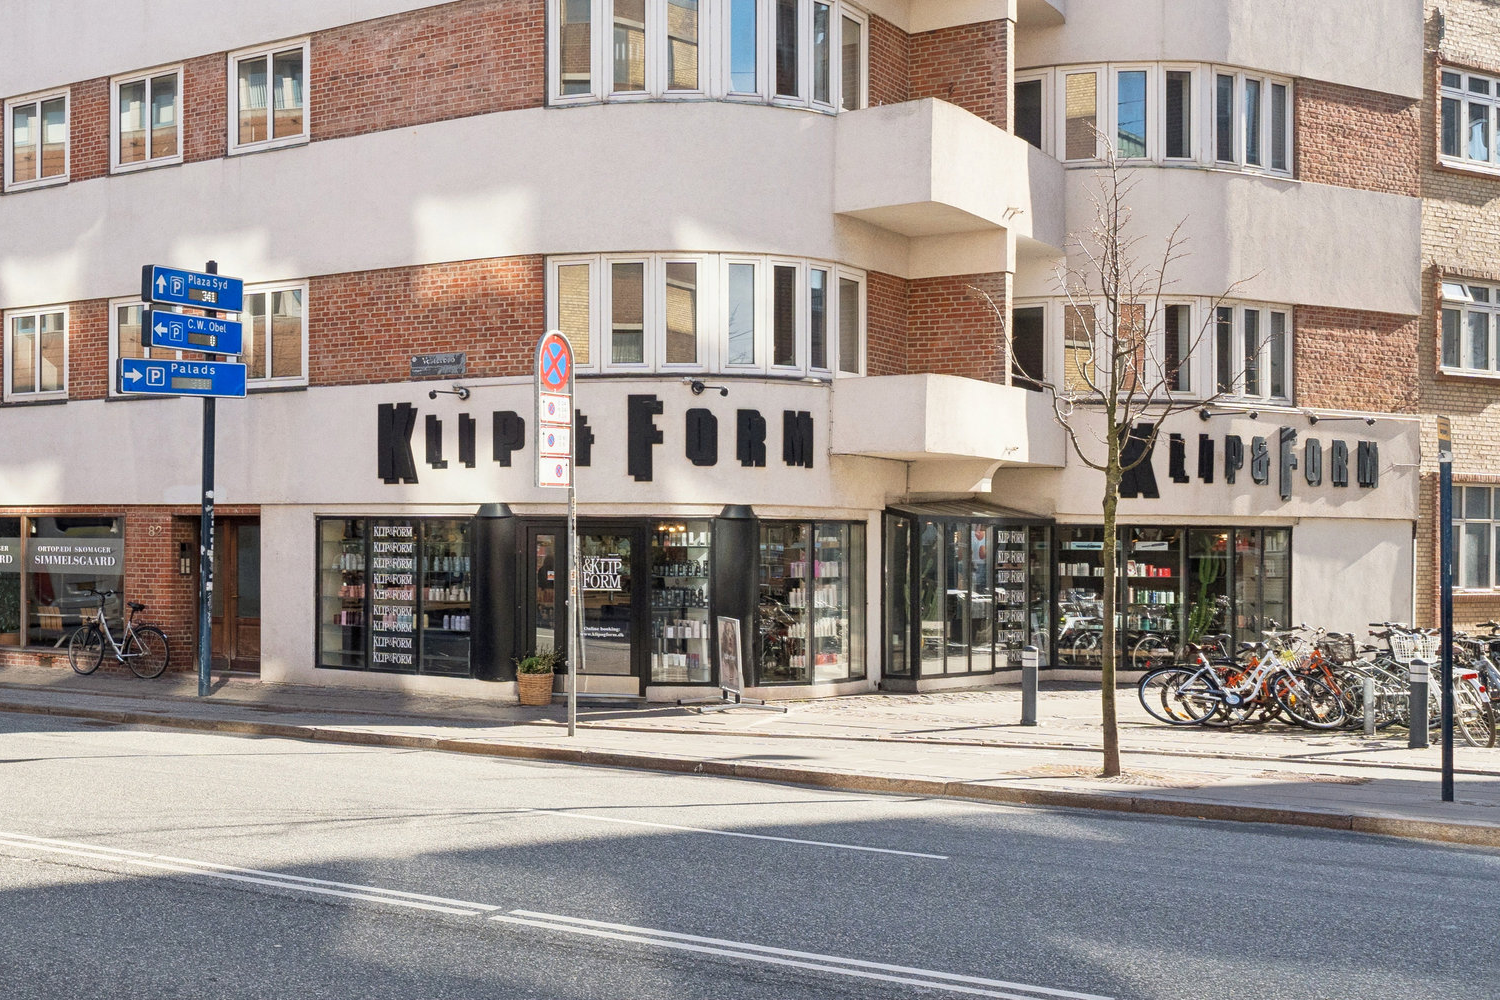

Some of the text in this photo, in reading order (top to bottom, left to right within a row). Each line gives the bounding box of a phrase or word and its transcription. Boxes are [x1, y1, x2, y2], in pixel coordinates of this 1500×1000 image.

[188, 274, 228, 290] Plaza Syd
[187, 319, 227, 333] C.W. Obel
[171, 363, 215, 375] Palads
[148, 525, 162, 537] 82
[34, 555, 116, 566] SIMMELSGAARD
[582, 572, 622, 589] FORM
